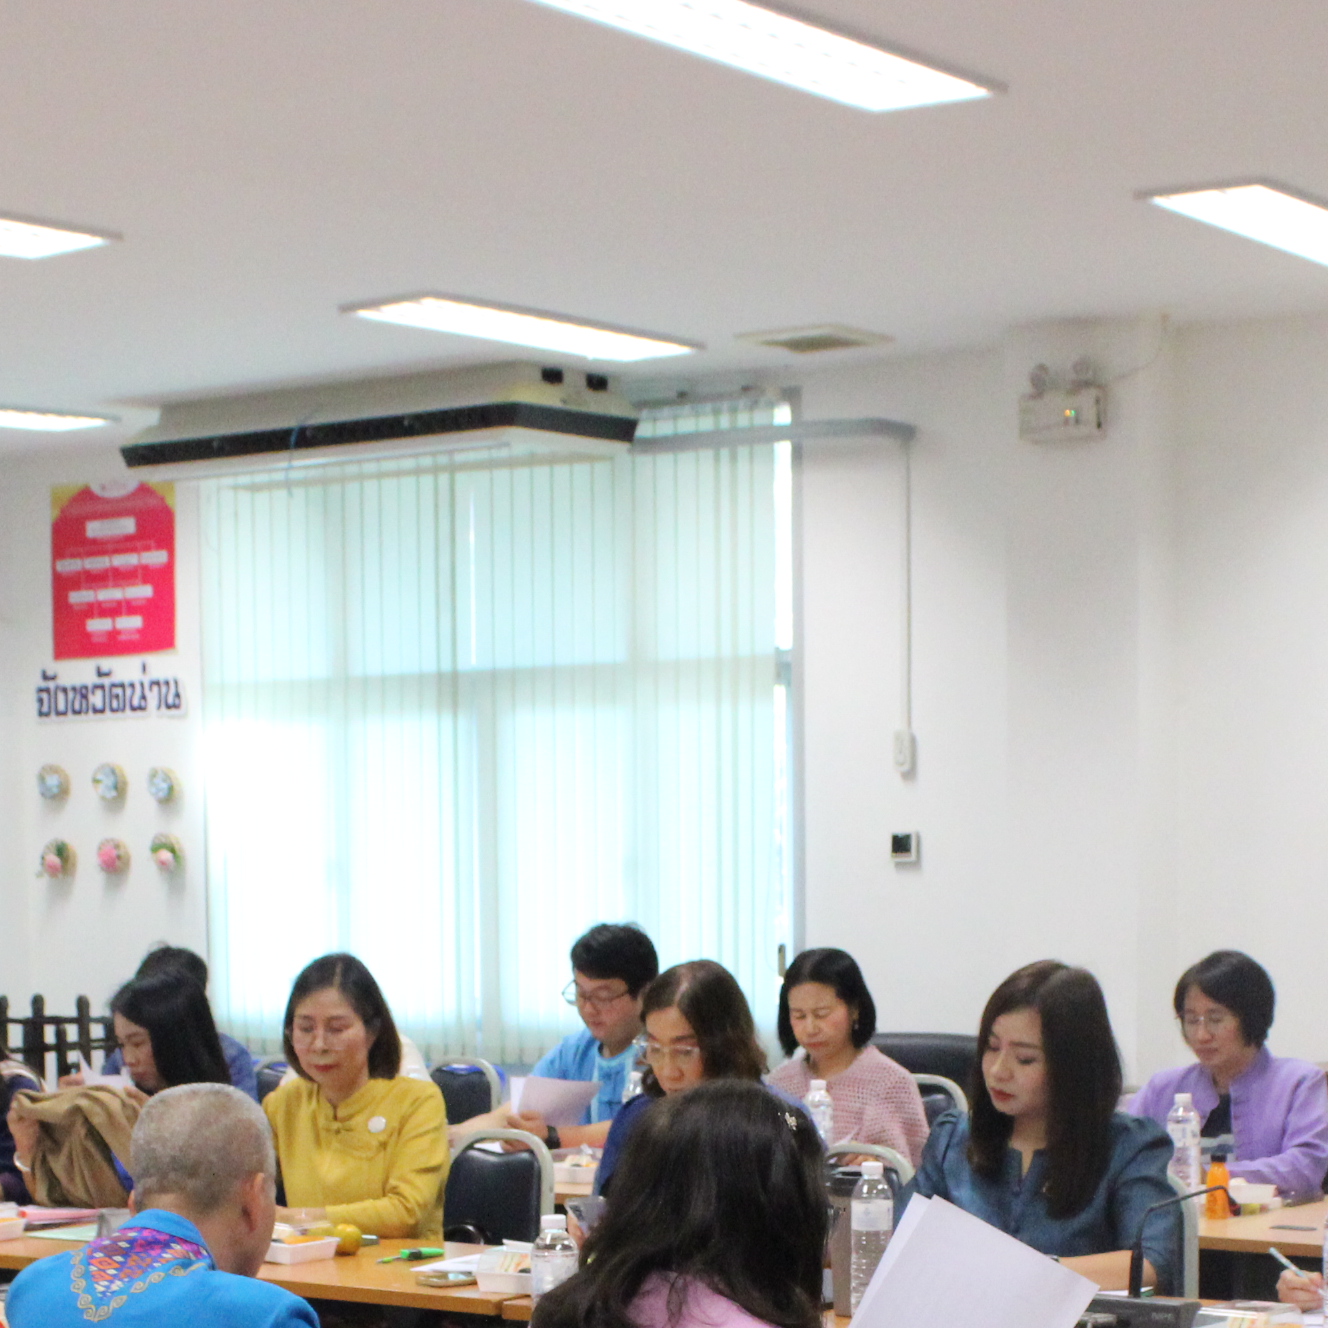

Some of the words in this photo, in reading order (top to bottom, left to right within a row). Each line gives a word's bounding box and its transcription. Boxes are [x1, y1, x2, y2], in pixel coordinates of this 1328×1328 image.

[36, 661, 182, 717] จังหวัดน่าน
